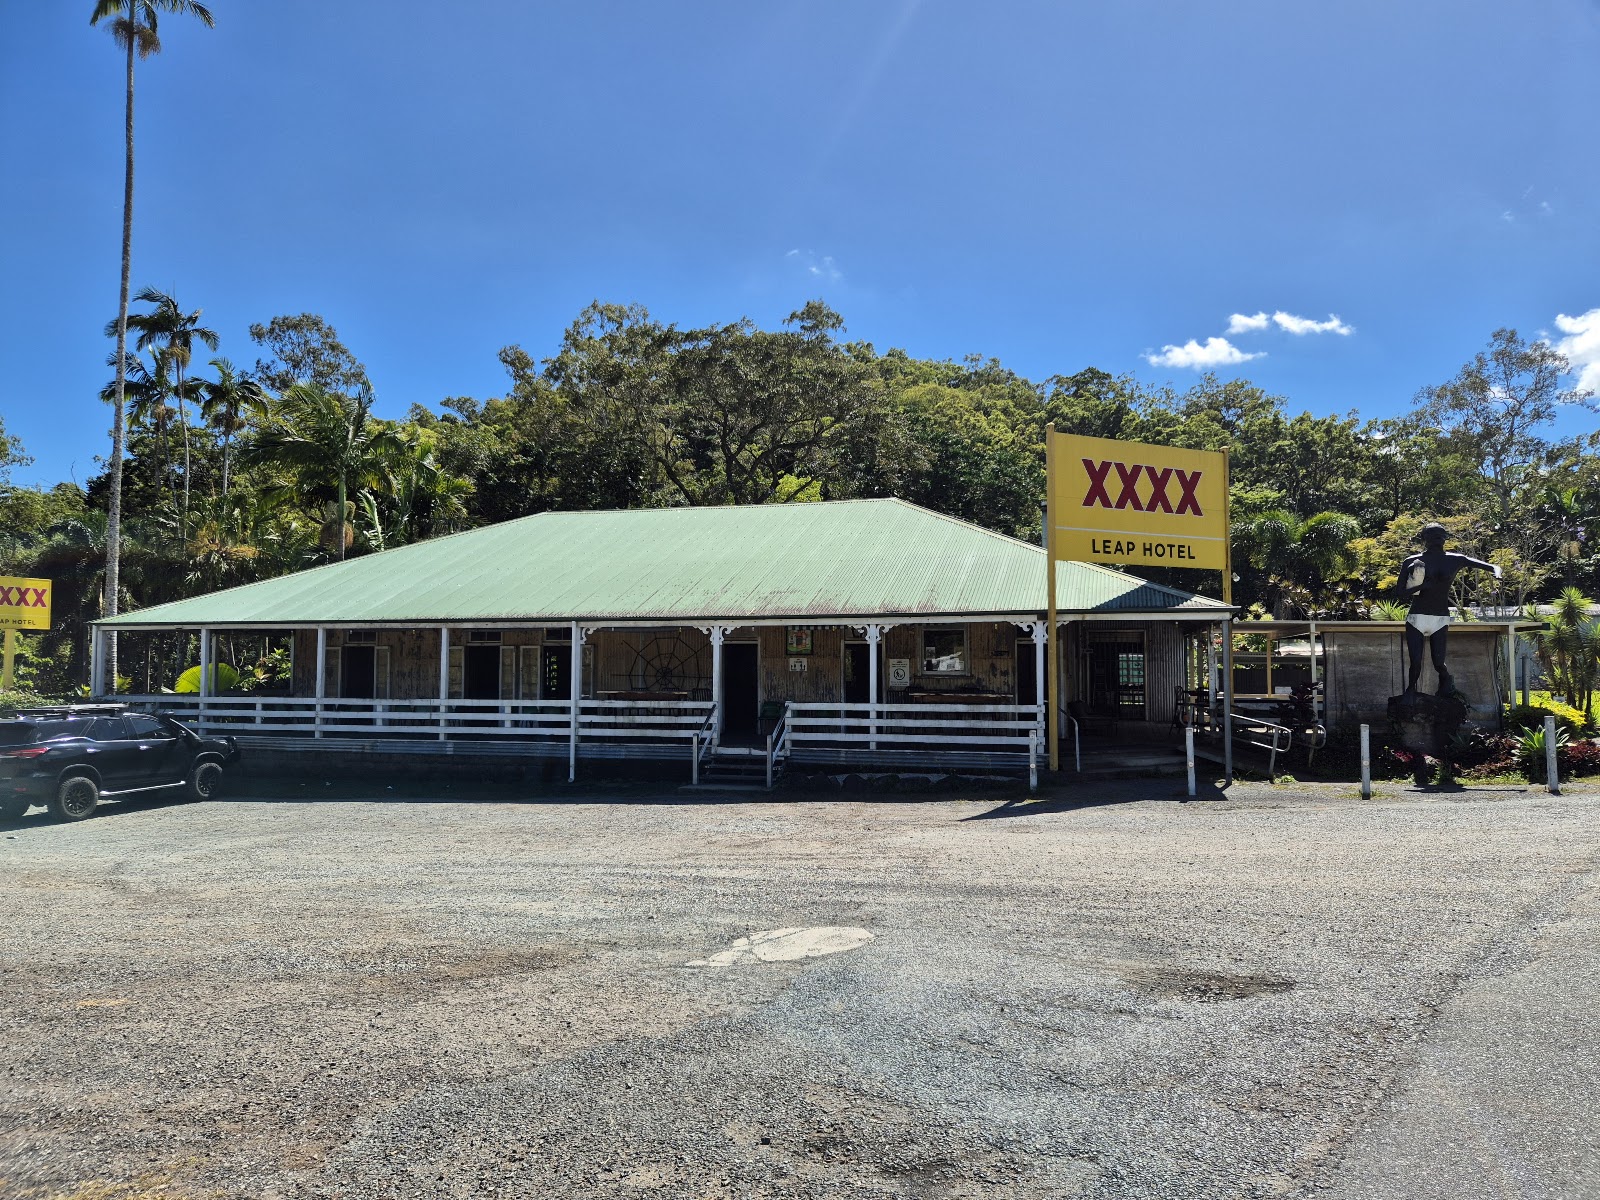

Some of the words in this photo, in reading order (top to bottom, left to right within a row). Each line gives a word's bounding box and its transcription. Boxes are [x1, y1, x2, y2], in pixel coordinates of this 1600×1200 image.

[1081, 458, 1204, 517] XXXX
[1092, 539, 1136, 556] LEAP
[1143, 542, 1196, 560] HOTEL
